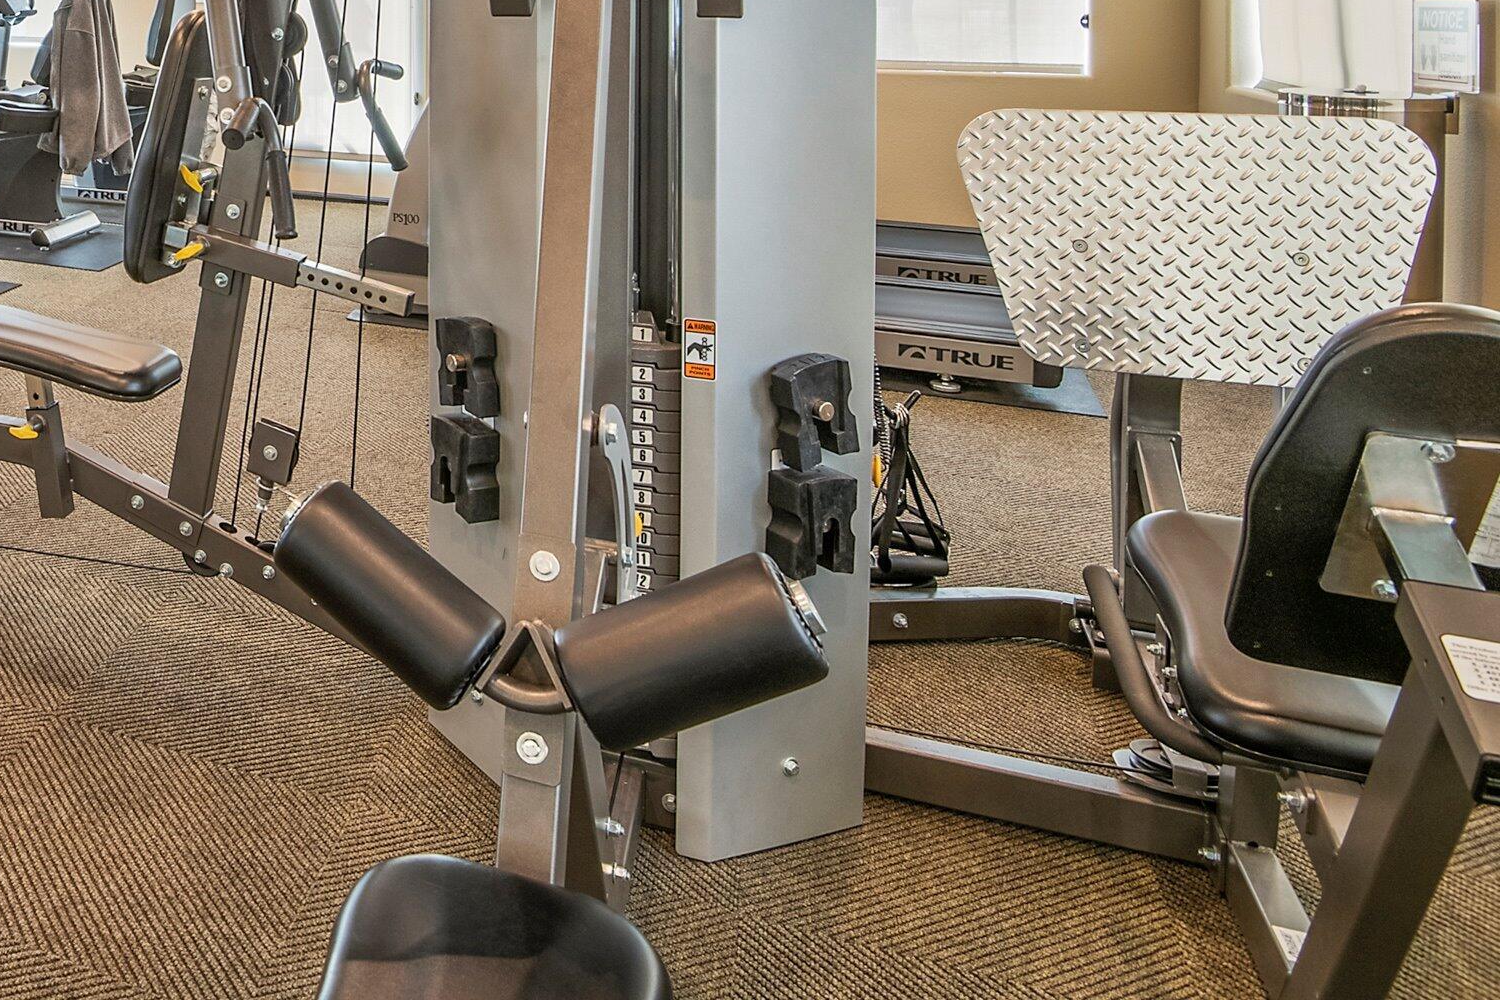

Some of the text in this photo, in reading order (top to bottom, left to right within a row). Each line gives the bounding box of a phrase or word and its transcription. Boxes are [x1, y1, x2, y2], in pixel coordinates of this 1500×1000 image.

[1421, 10, 1465, 29] NOTICE
[392, 212, 420, 226] PS100
[920, 268, 988, 286] TRUE
[640, 328, 645, 340] 1
[929, 347, 1014, 371] TRUE
[639, 368, 646, 380] 2
[639, 388, 646, 400] 3
[639, 410, 647, 422] 4
[639, 431, 646, 443] 5
[639, 450, 646, 461] 6
[638, 470, 645, 482] 7
[638, 491, 645, 503] 8
